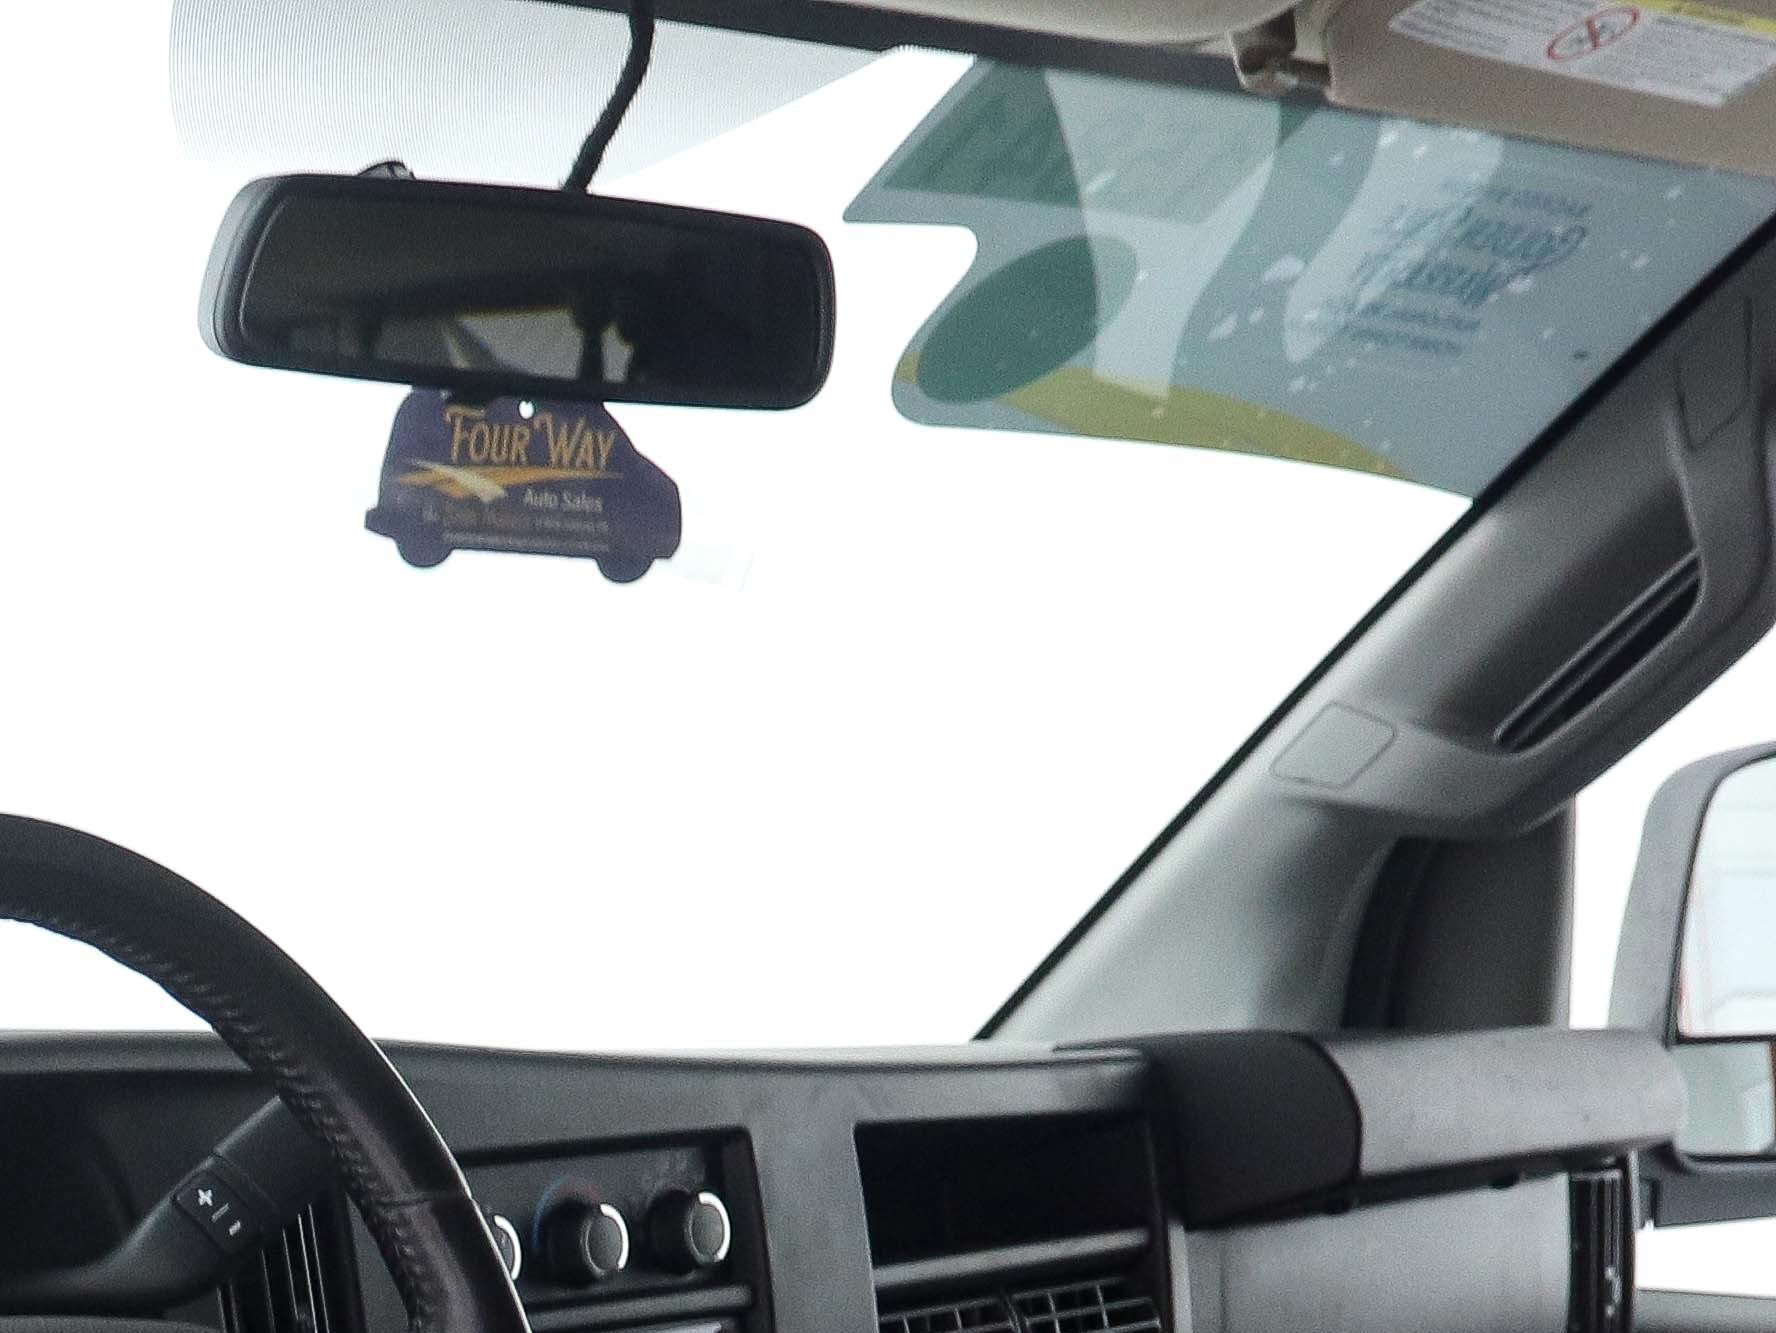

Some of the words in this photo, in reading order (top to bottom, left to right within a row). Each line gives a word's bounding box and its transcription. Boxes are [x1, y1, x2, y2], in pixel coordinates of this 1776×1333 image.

[444, 404, 531, 466] FOUR
[533, 410, 615, 471] WAY
[523, 487, 559, 509] Auto
[562, 490, 603, 513] Sales
